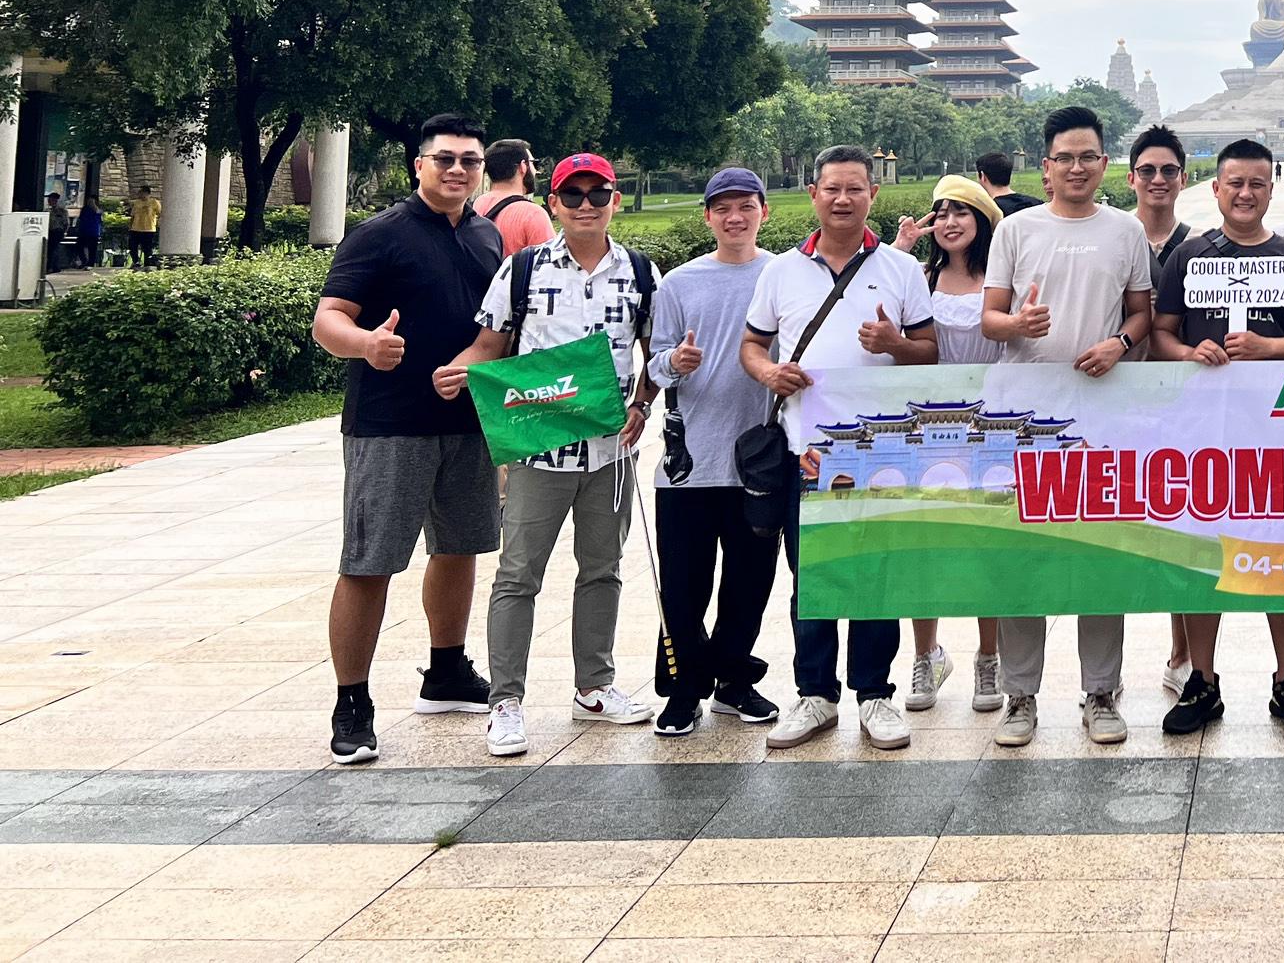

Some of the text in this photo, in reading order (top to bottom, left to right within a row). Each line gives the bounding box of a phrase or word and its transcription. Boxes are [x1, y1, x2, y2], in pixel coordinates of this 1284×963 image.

[1191, 261, 1235, 276] COOLER
[1188, 289, 1252, 304] COMPUTEX
[1206, 309, 1274, 323] FOULA
